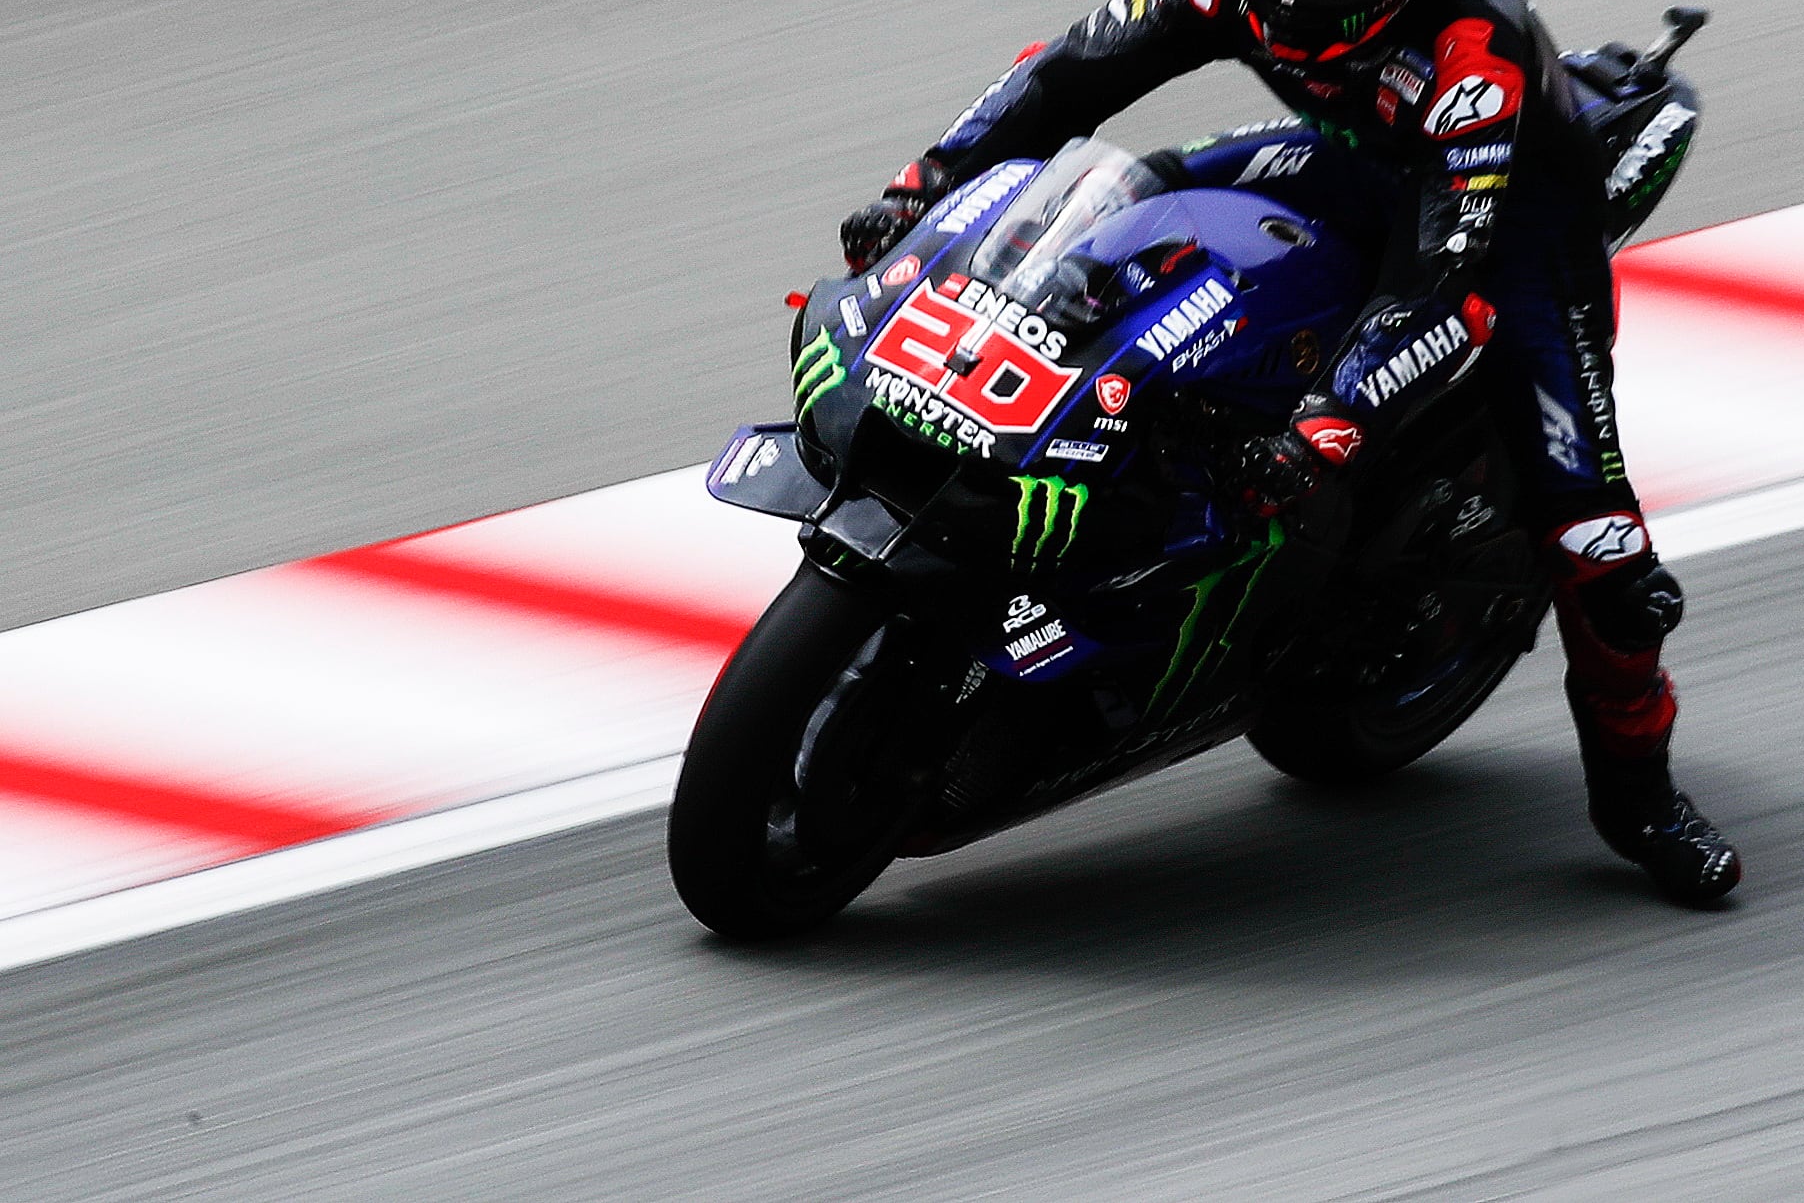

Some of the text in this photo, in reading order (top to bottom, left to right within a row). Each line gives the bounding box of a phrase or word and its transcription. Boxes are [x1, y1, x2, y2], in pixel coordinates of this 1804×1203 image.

[864, 276, 1084, 434] 20
[957, 277, 1068, 361] ENEOS
[1135, 277, 1235, 362] YAMAHA
[1171, 328, 1216, 374] BLUE
[1192, 331, 1229, 369] FAST
[1356, 314, 1470, 408] YAMAHA
[864, 366, 997, 459] MONSTER
[871, 395, 970, 456] ENERGY
[1002, 603, 1047, 635] RCB
[1004, 618, 1067, 662] YAMALUBE
